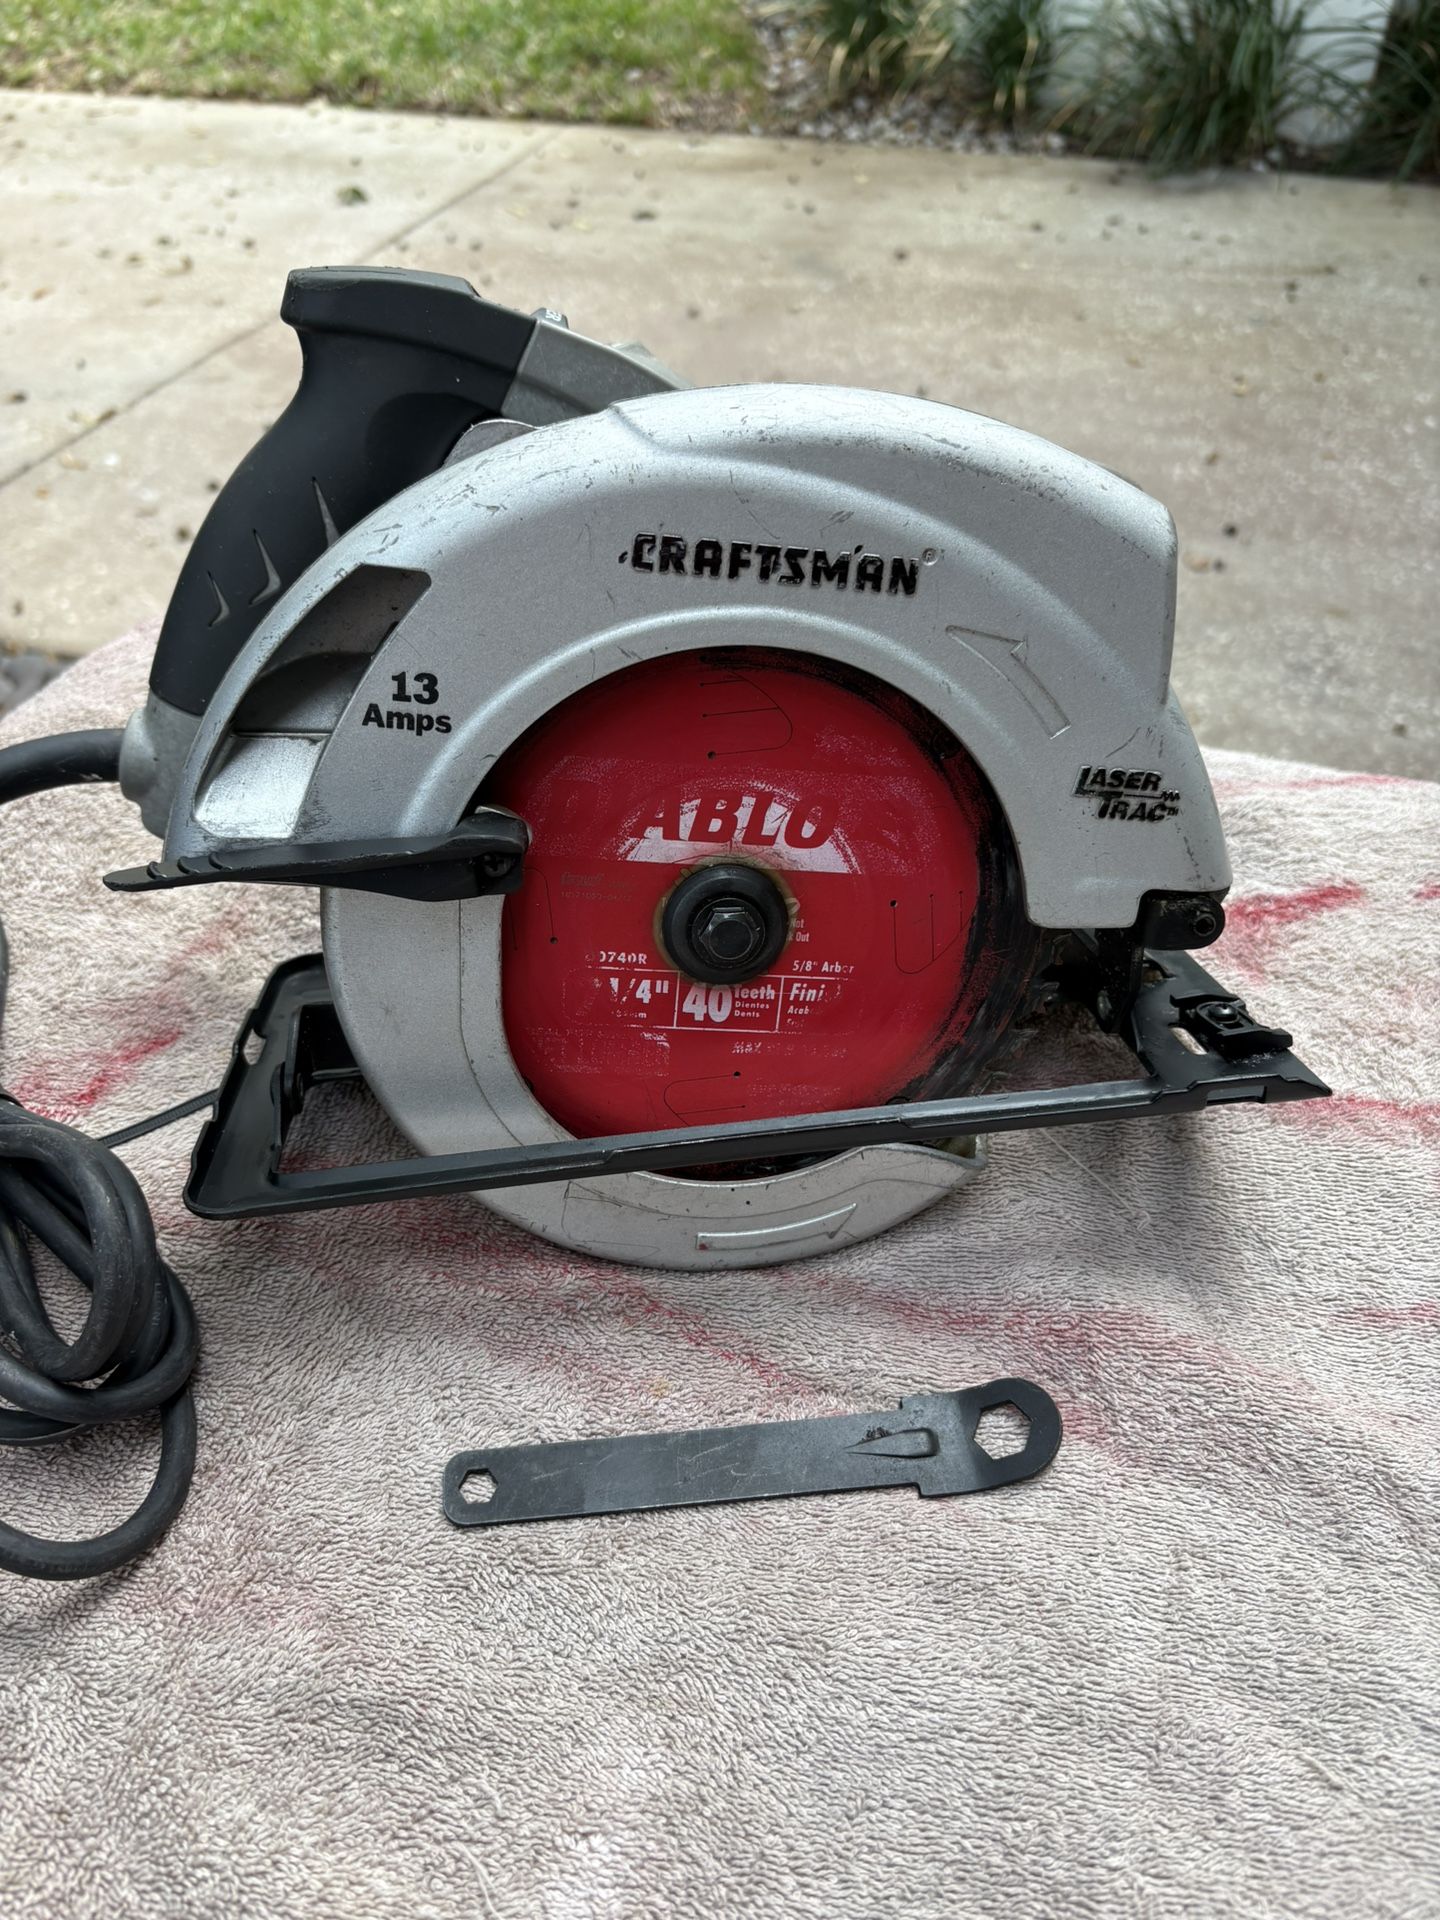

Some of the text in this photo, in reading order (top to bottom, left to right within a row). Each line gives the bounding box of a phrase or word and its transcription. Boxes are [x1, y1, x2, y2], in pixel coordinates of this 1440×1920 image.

[391, 671, 440, 705] 13
[361, 703, 453, 737] Amps
[1073, 765, 1162, 796] LASER
[795, 931, 810, 942] Out
[682, 982, 733, 1023] 40
[733, 983, 775, 1000] Teeth
[734, 1009, 760, 1018] Dents
[735, 1001, 770, 1009] Dientes
